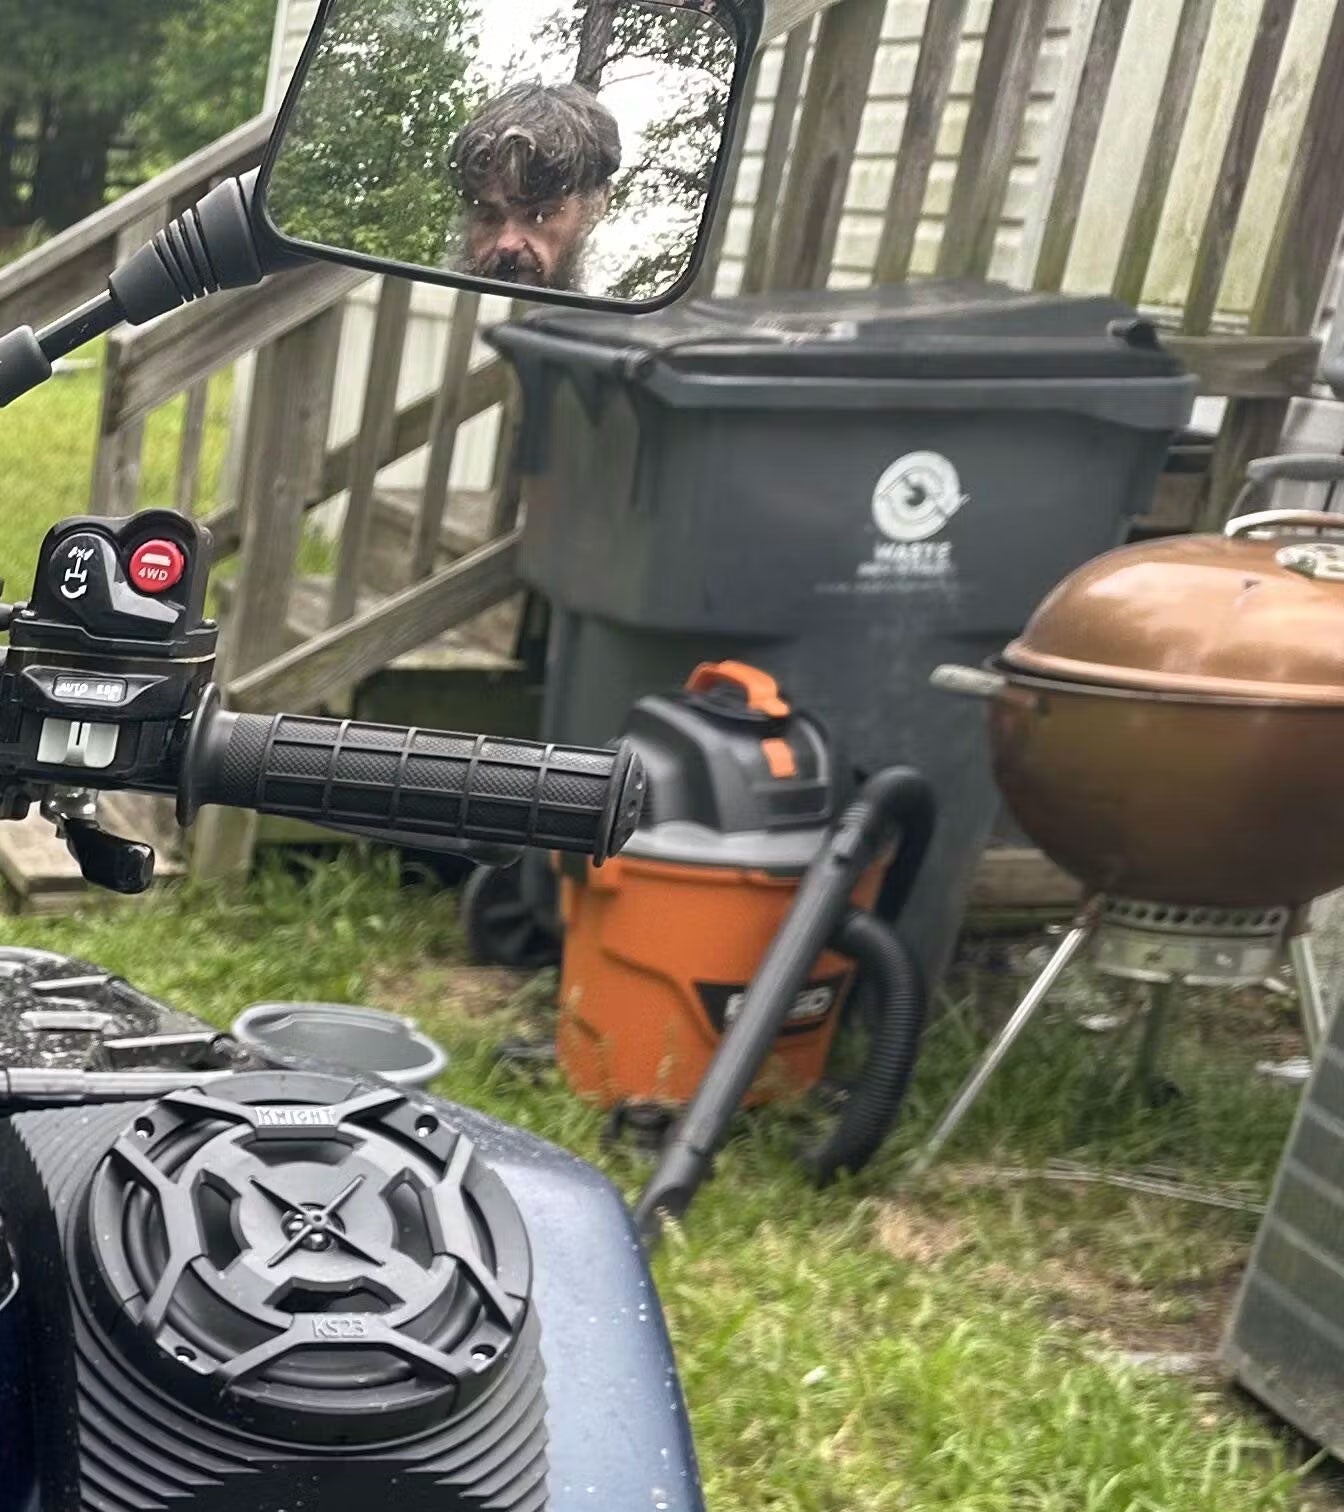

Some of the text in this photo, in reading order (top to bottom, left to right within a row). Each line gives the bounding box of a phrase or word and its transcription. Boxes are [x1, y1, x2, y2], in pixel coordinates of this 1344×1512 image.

[138, 567, 168, 581] 4WD
[255, 1107, 340, 1126] KNIGHT
[311, 1315, 369, 1339] KS23
